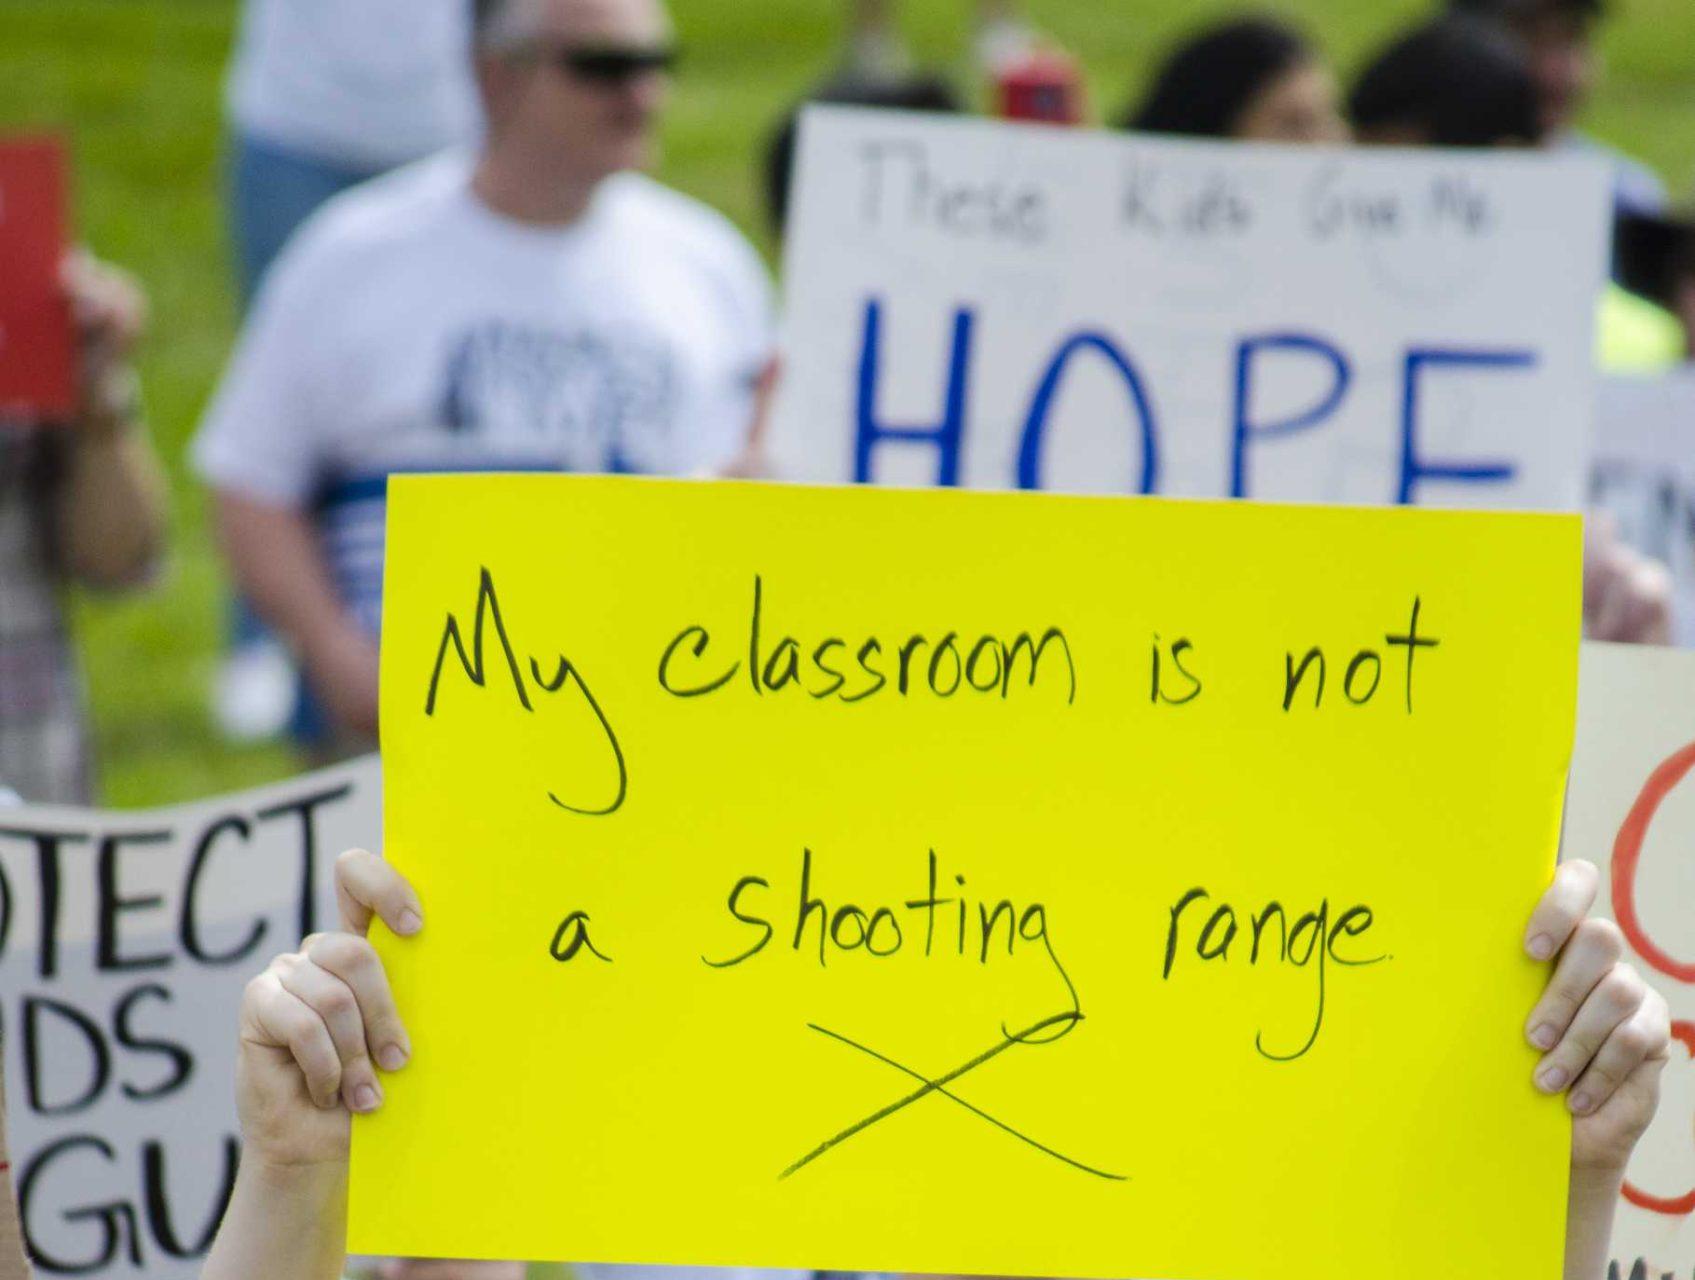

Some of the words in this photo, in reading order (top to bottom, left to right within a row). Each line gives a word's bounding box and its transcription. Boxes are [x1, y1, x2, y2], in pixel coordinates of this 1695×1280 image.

[425, 566, 627, 815] My
[658, 575, 1075, 704] classroom
[1151, 638, 1201, 704] is
[1283, 596, 1439, 713] not
[0, 778, 354, 980] TECT
[550, 911, 612, 962] a
[702, 848, 1079, 1043] shooting
